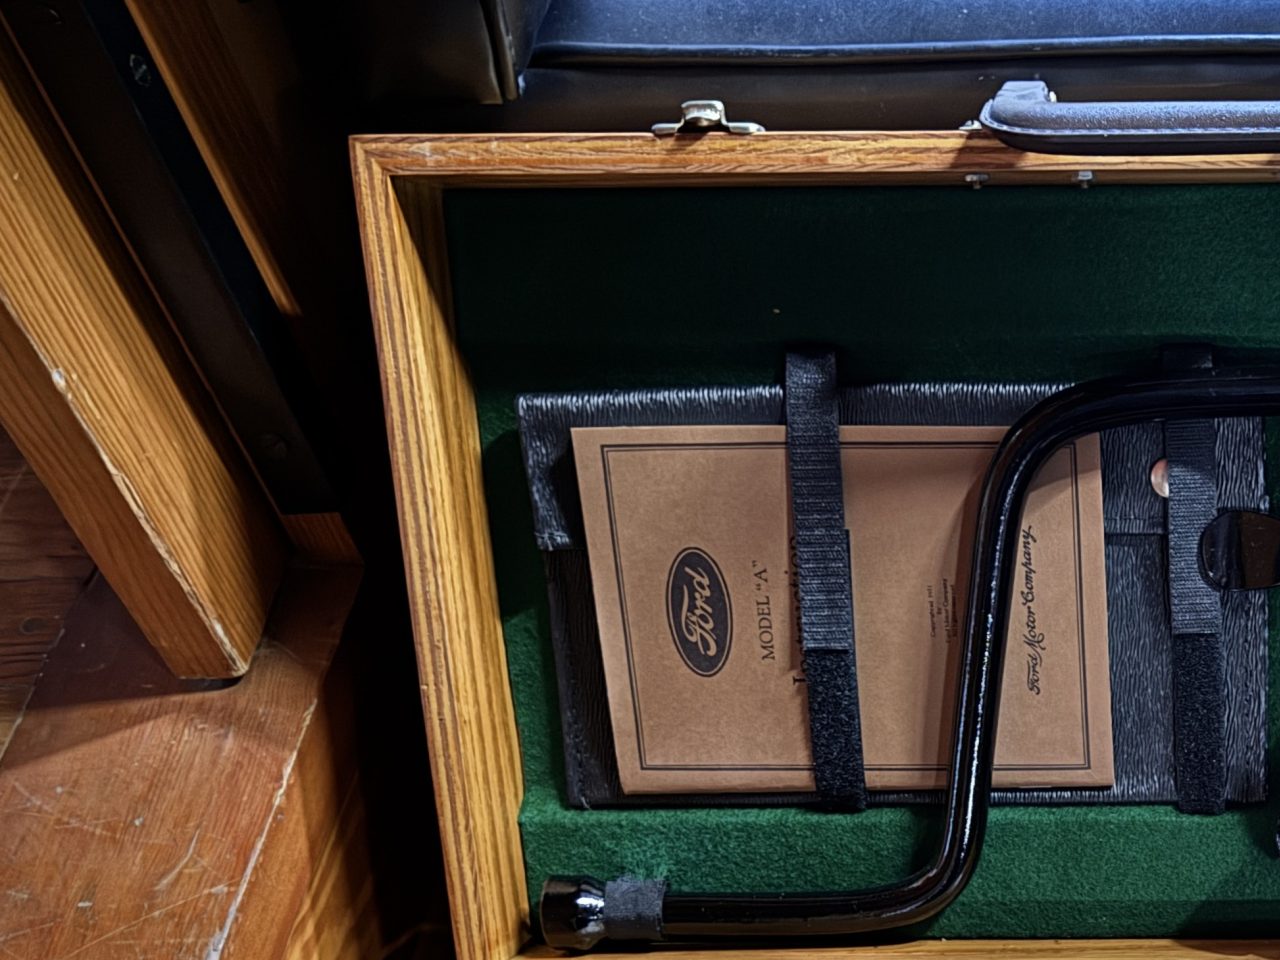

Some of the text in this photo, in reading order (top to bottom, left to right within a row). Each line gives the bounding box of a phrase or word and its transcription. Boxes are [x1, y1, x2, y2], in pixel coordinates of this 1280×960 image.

[681, 566, 718, 656] Ford
[756, 595, 776, 661] MODEL
[1020, 525, 1047, 696] Ford Motor Company
